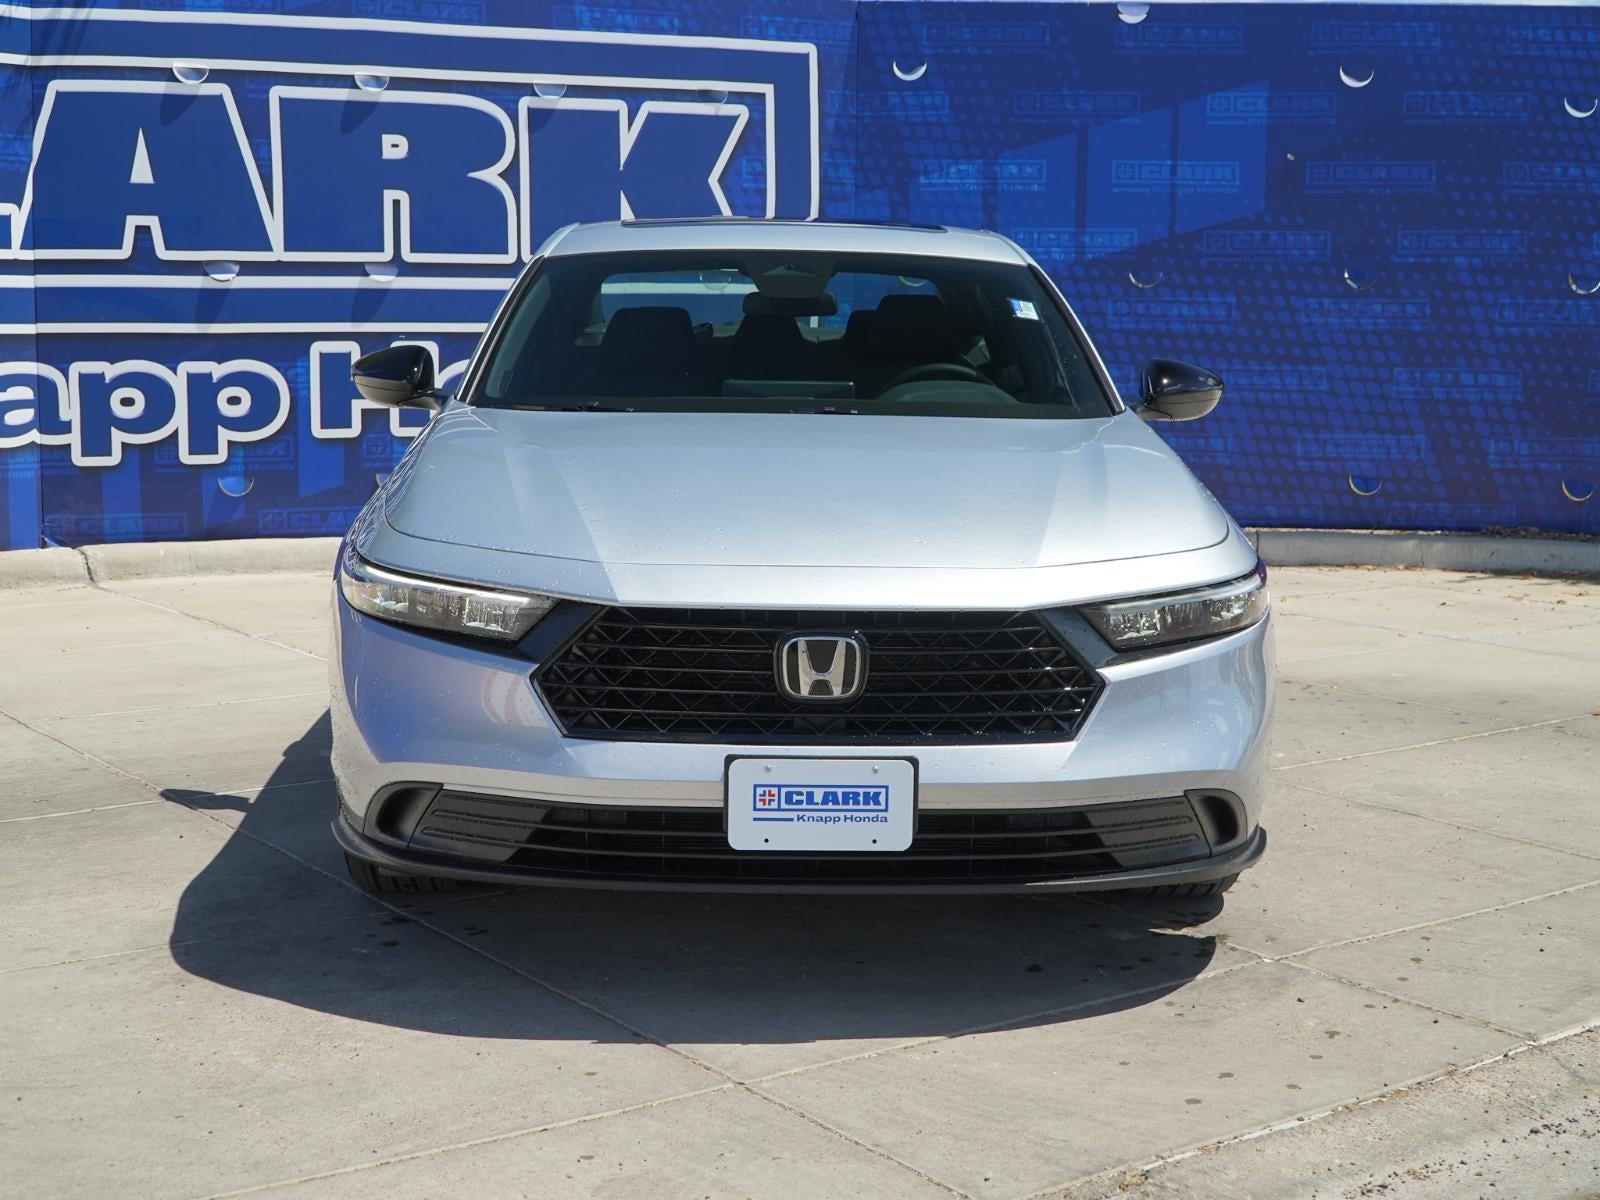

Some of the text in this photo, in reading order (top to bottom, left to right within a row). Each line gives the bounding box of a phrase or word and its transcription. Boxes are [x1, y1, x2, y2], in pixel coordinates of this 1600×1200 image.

[0, 79, 750, 264] ARK
[784, 790, 882, 807] CLARK
[796, 813, 888, 825] Knapp Honda
